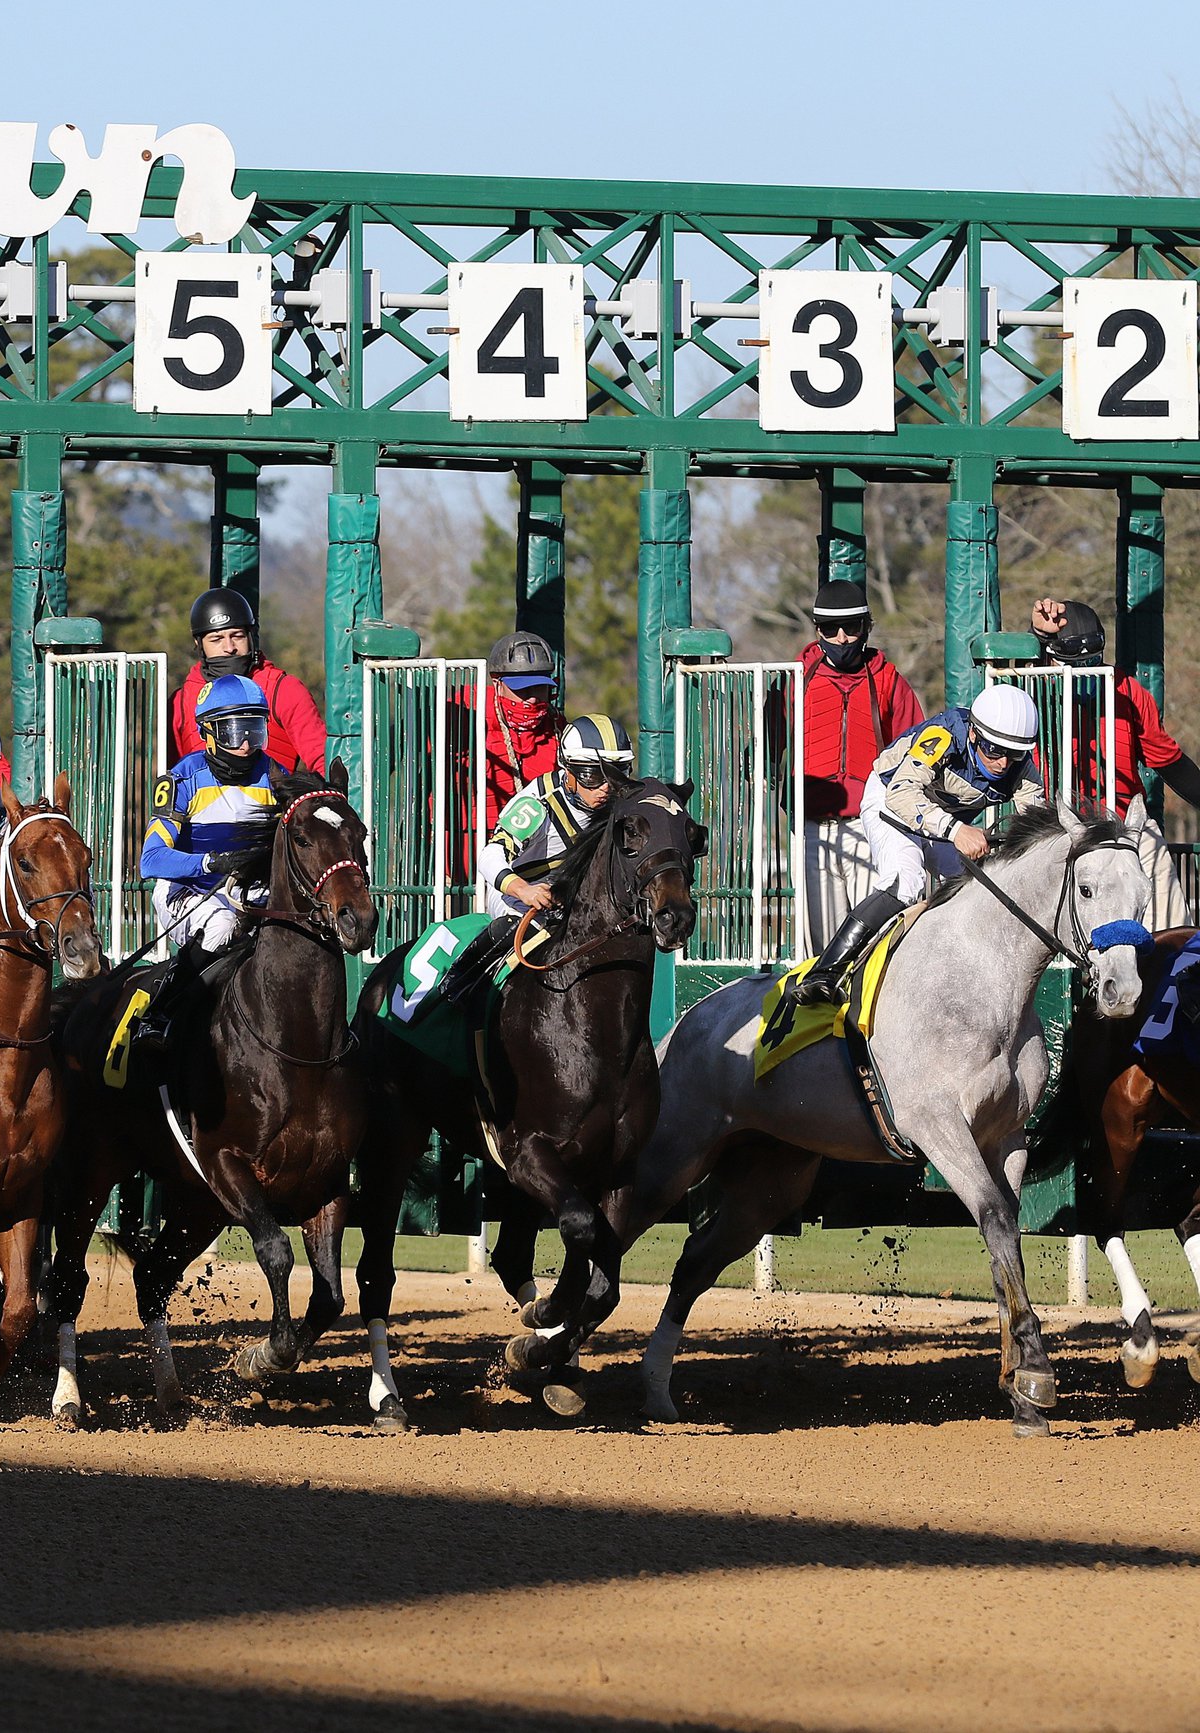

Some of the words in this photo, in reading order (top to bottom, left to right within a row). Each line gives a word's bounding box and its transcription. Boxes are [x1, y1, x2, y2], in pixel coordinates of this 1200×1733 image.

[164, 280, 244, 390] 5
[478, 288, 559, 397] 4
[791, 300, 862, 408] 3
[1098, 309, 1169, 417] 2
[154, 781, 170, 808] 6
[919, 737, 942, 756] 4
[510, 802, 540, 830] 5
[391, 923, 460, 1024] 5
[761, 972, 801, 1052] 4
